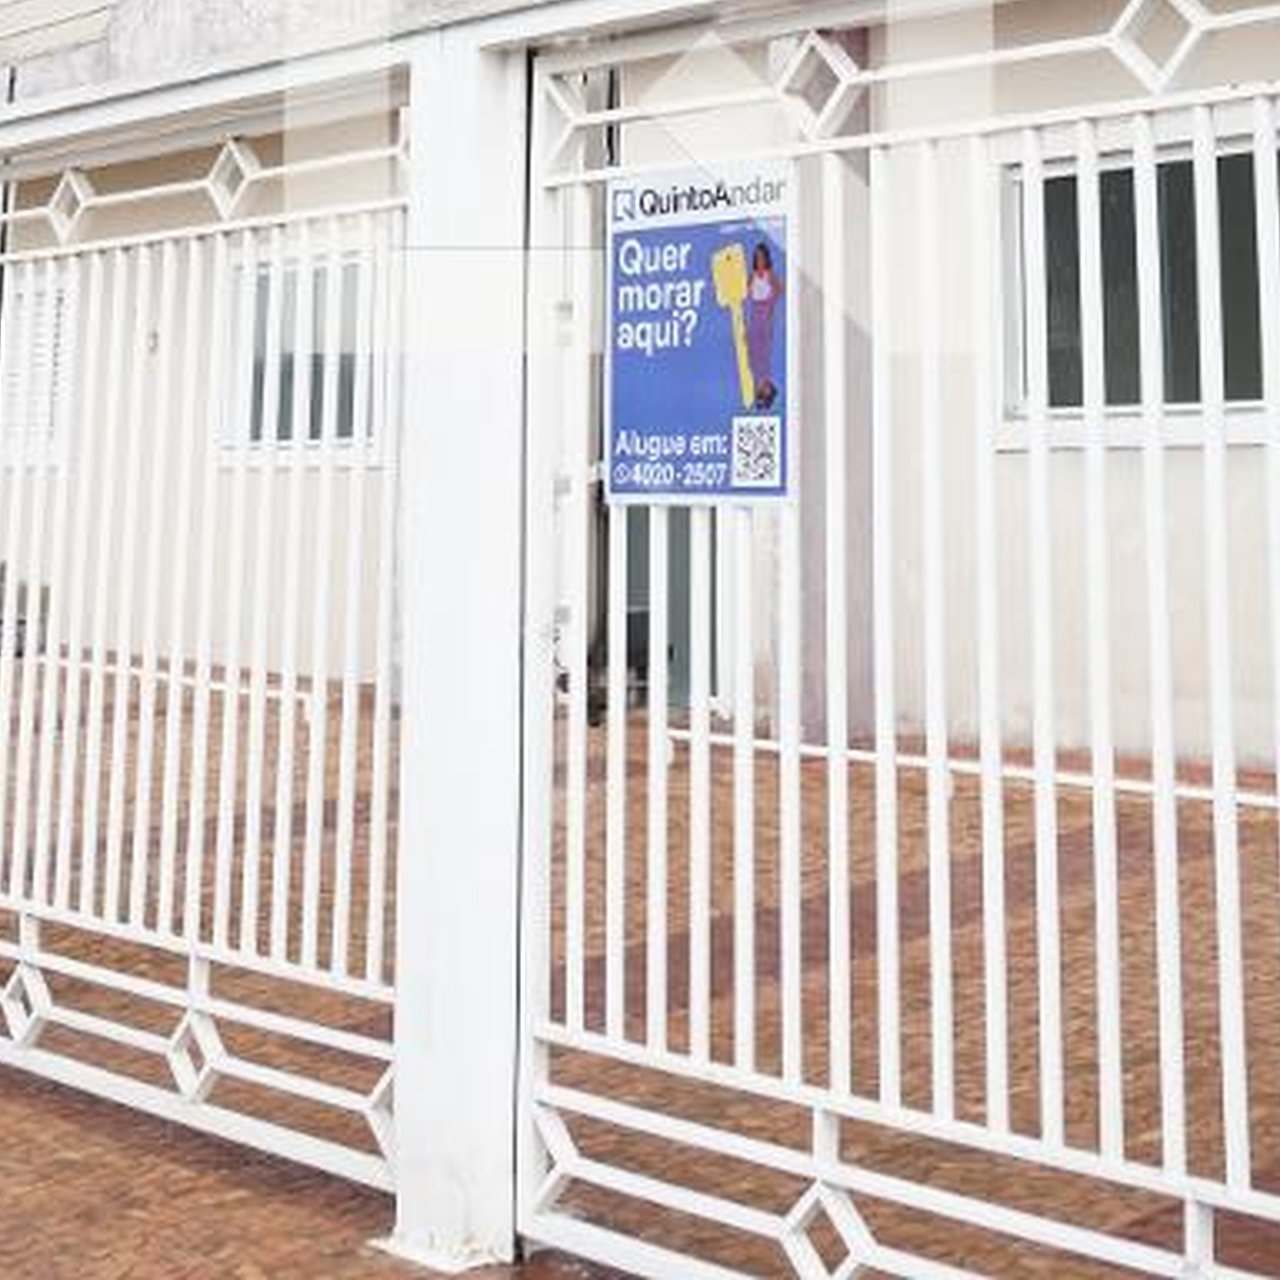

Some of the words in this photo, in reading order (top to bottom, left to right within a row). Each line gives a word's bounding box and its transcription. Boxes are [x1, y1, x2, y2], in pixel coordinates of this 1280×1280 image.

[639, 177, 785, 216] QuintoAndar
[620, 239, 691, 275] Quer
[619, 280, 704, 311] morar
[618, 309, 697, 357] aqui?
[615, 430, 686, 461] Alugue
[689, 433, 728, 455] em:
